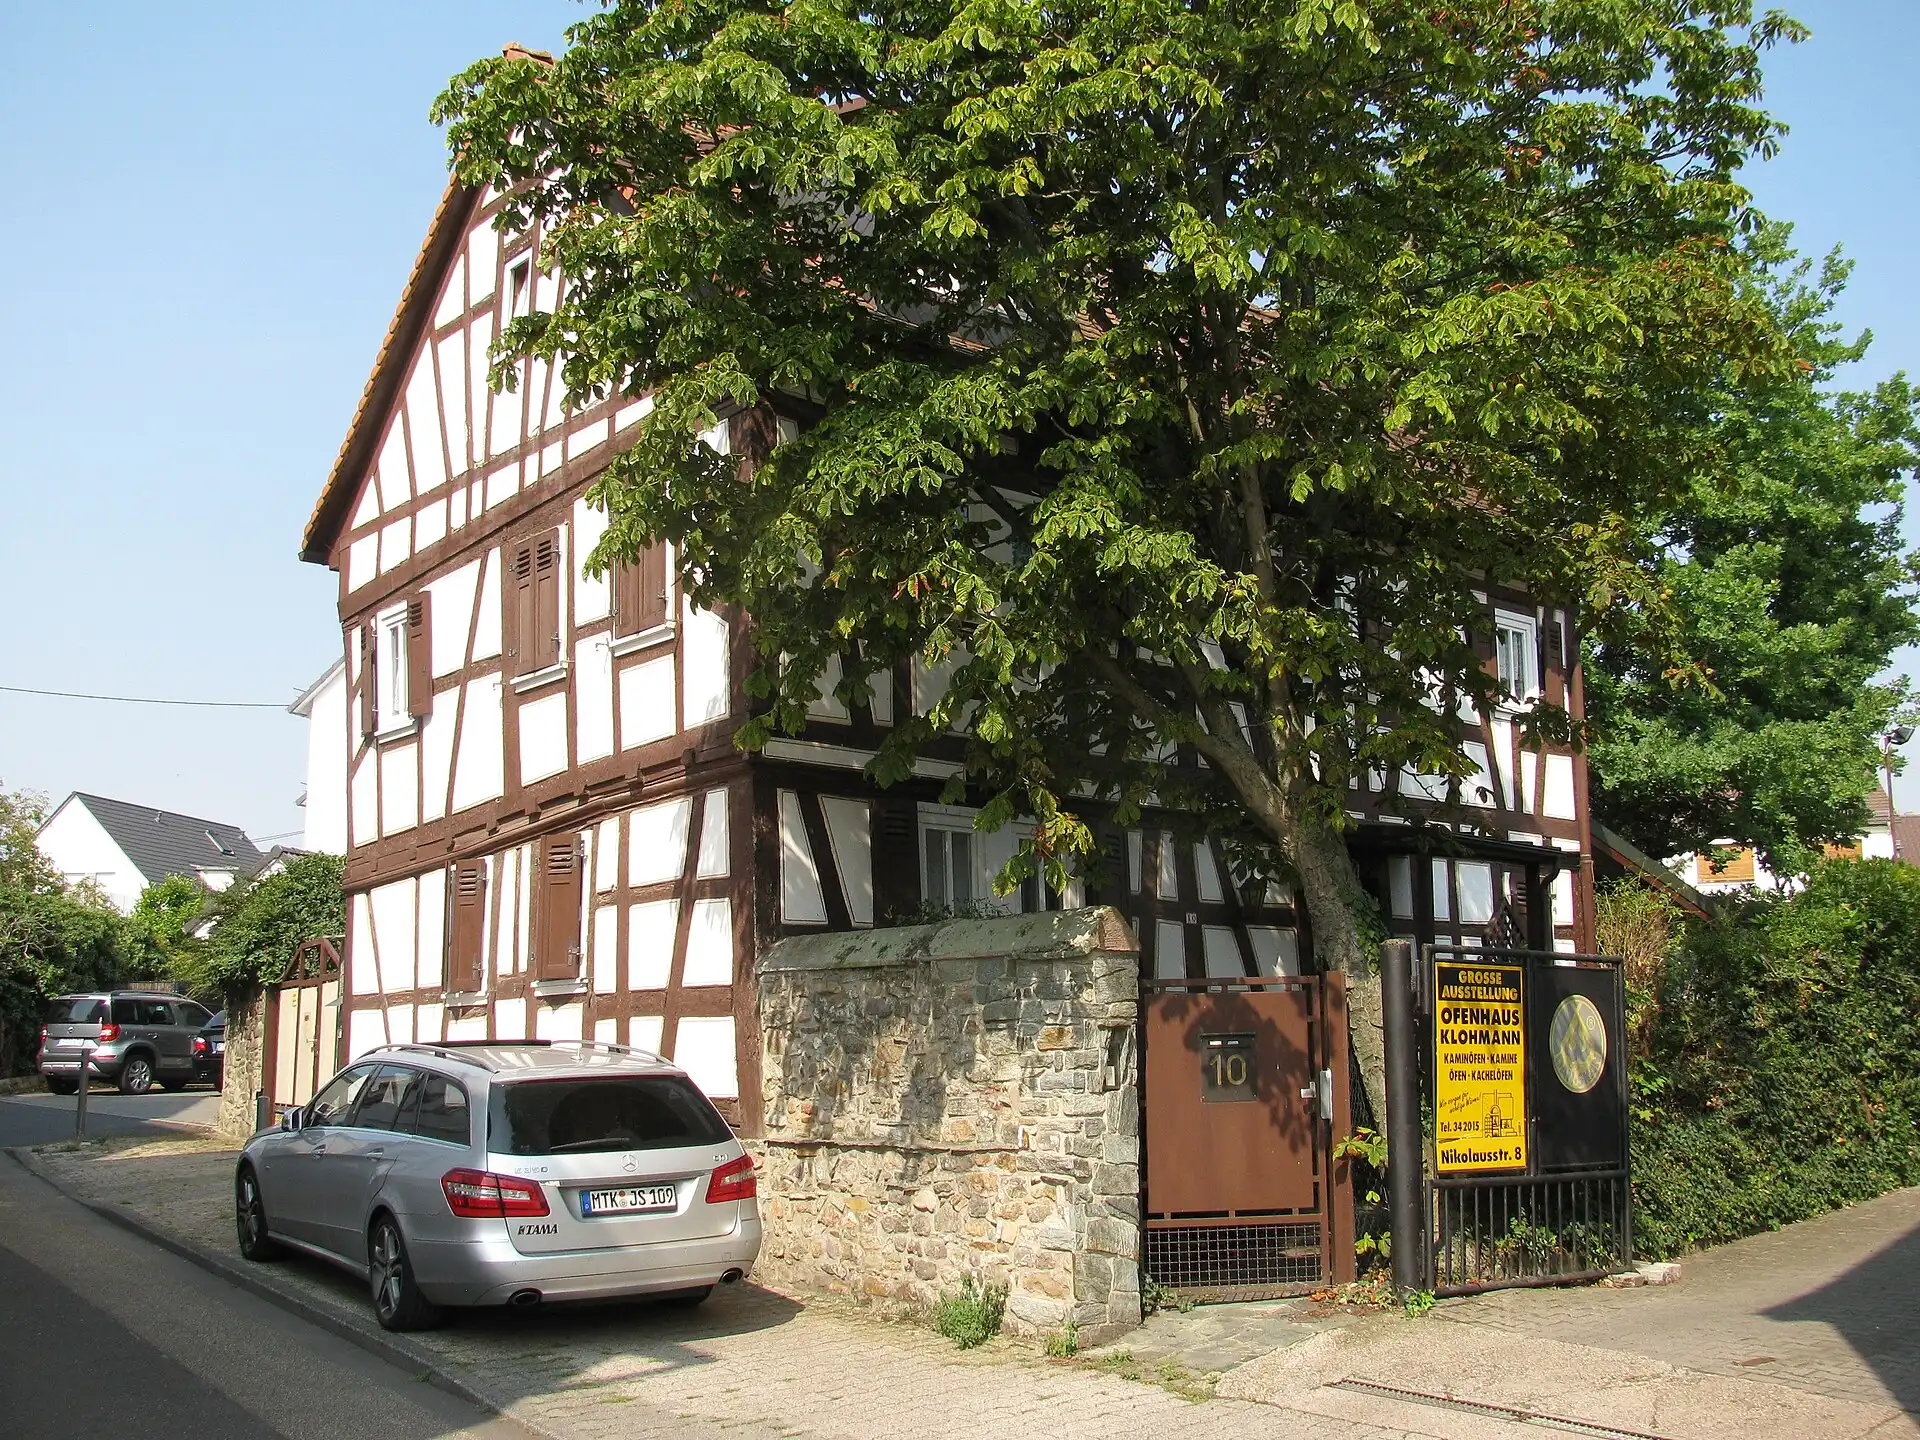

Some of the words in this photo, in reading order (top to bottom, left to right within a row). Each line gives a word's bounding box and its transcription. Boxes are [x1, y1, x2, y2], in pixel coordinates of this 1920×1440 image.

[1458, 970, 1502, 985] GROSSE
[1441, 984, 1518, 1001] AUSSTELLUNG
[1440, 1007, 1520, 1026] OFENHAUS
[1440, 1029, 1521, 1045] KLOHMANN
[1444, 1051, 1486, 1064] KAMINÖFEN
[1490, 1053, 1518, 1064] KAMINE
[1209, 1053, 1247, 1086] 10
[1449, 1068, 1467, 1081] ÖFEN
[1471, 1068, 1513, 1081] KACHELÖFEN
[1440, 1121, 1452, 1133] Tel.
[1441, 1148, 1512, 1165] Nikolausstr.
[1514, 1146, 1522, 1161] 8
[591, 1191, 618, 1210] MTK
[630, 1189, 647, 1206] JS
[649, 1187, 673, 1205] 109
